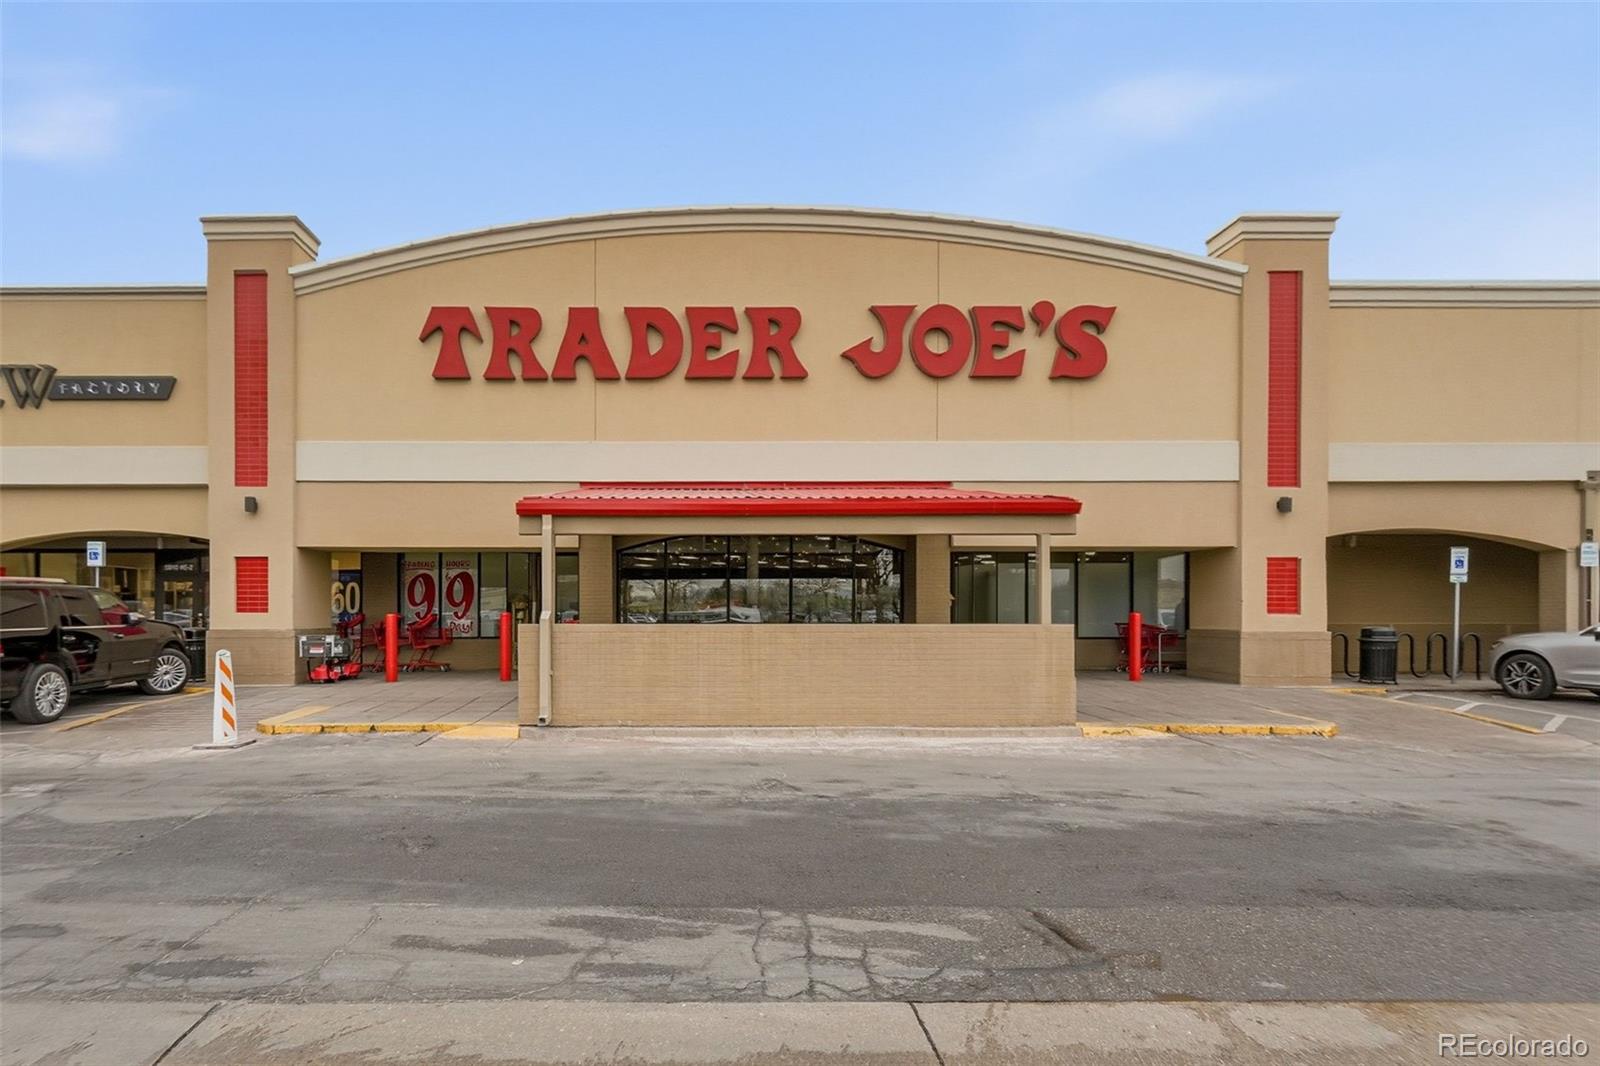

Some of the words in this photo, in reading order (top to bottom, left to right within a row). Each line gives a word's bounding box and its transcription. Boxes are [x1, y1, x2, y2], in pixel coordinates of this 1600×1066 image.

[419, 305, 808, 381] TRADER
[841, 299, 1117, 381] JOE'S
[58, 380, 161, 395] FACTORY
[331, 581, 361, 614] 60
[407, 572, 437, 620] 9
[445, 571, 475, 620] 9
